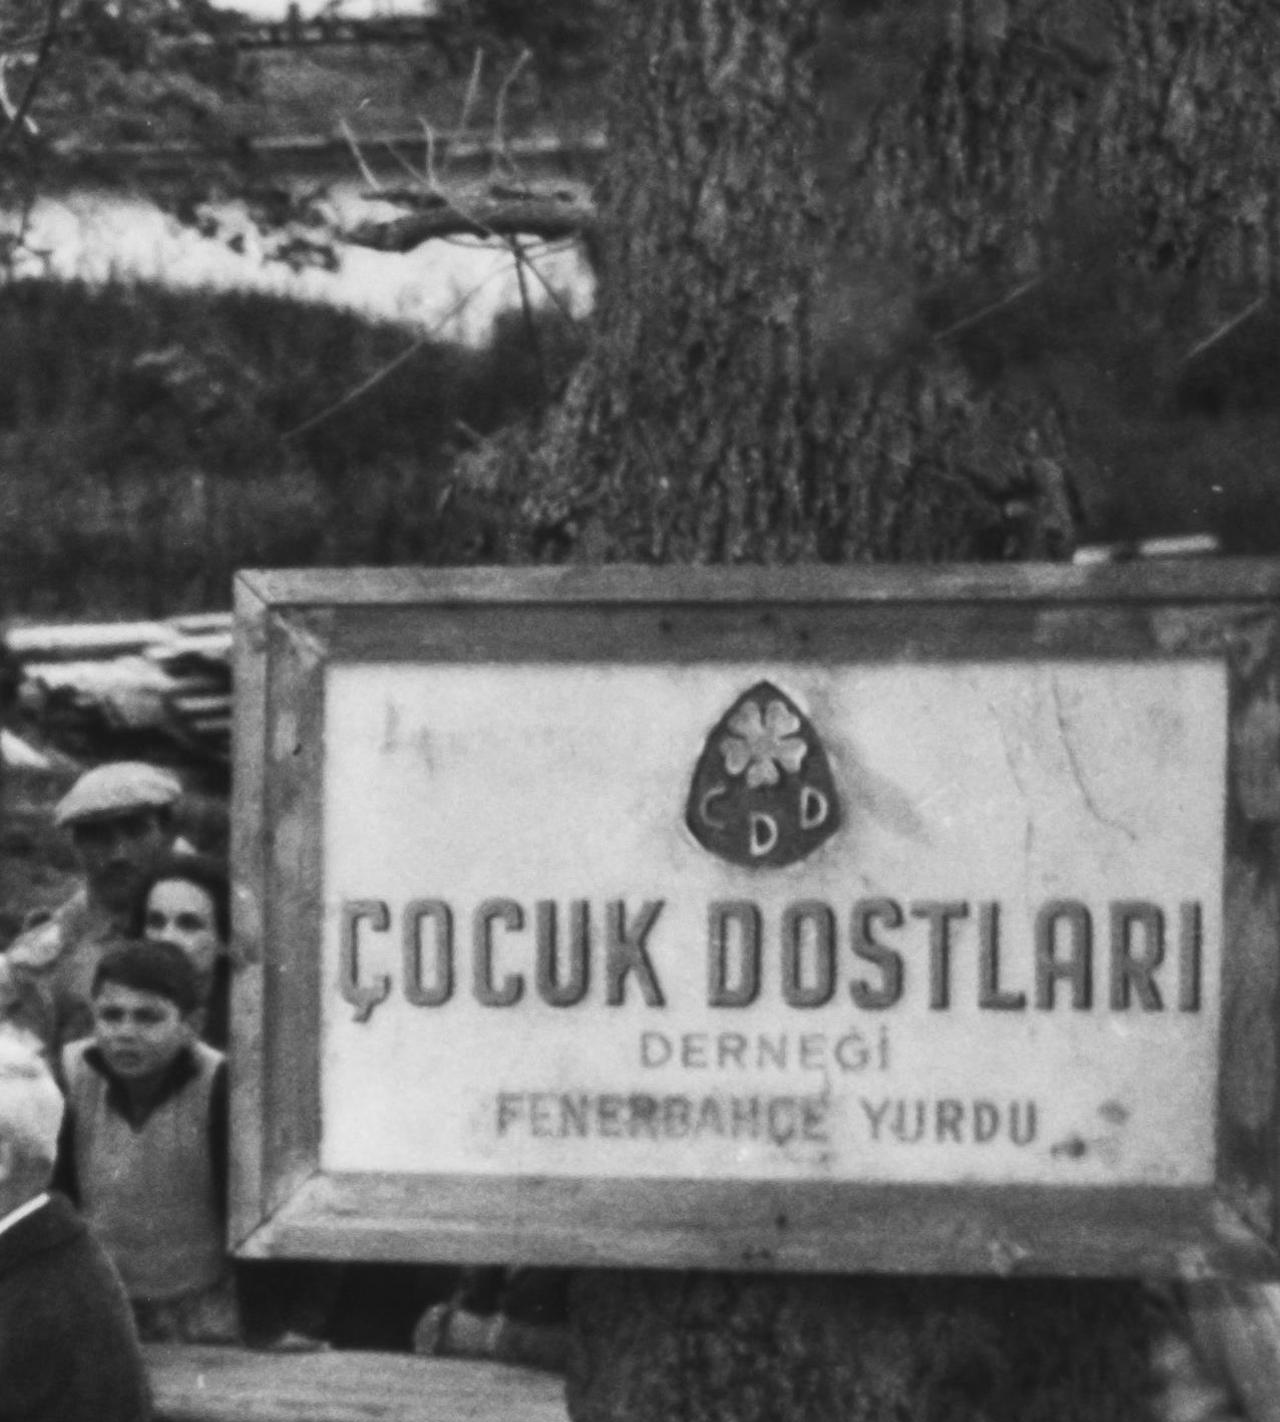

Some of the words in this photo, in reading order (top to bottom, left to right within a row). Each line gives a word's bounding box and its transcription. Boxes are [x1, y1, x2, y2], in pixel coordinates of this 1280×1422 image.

[336, 897, 668, 1023] ÇOCUK
[705, 897, 1203, 1015] DOSTLARI
[494, 1090, 832, 1147] FENERBAHÇE
[861, 1096, 1039, 1148] YURDU
